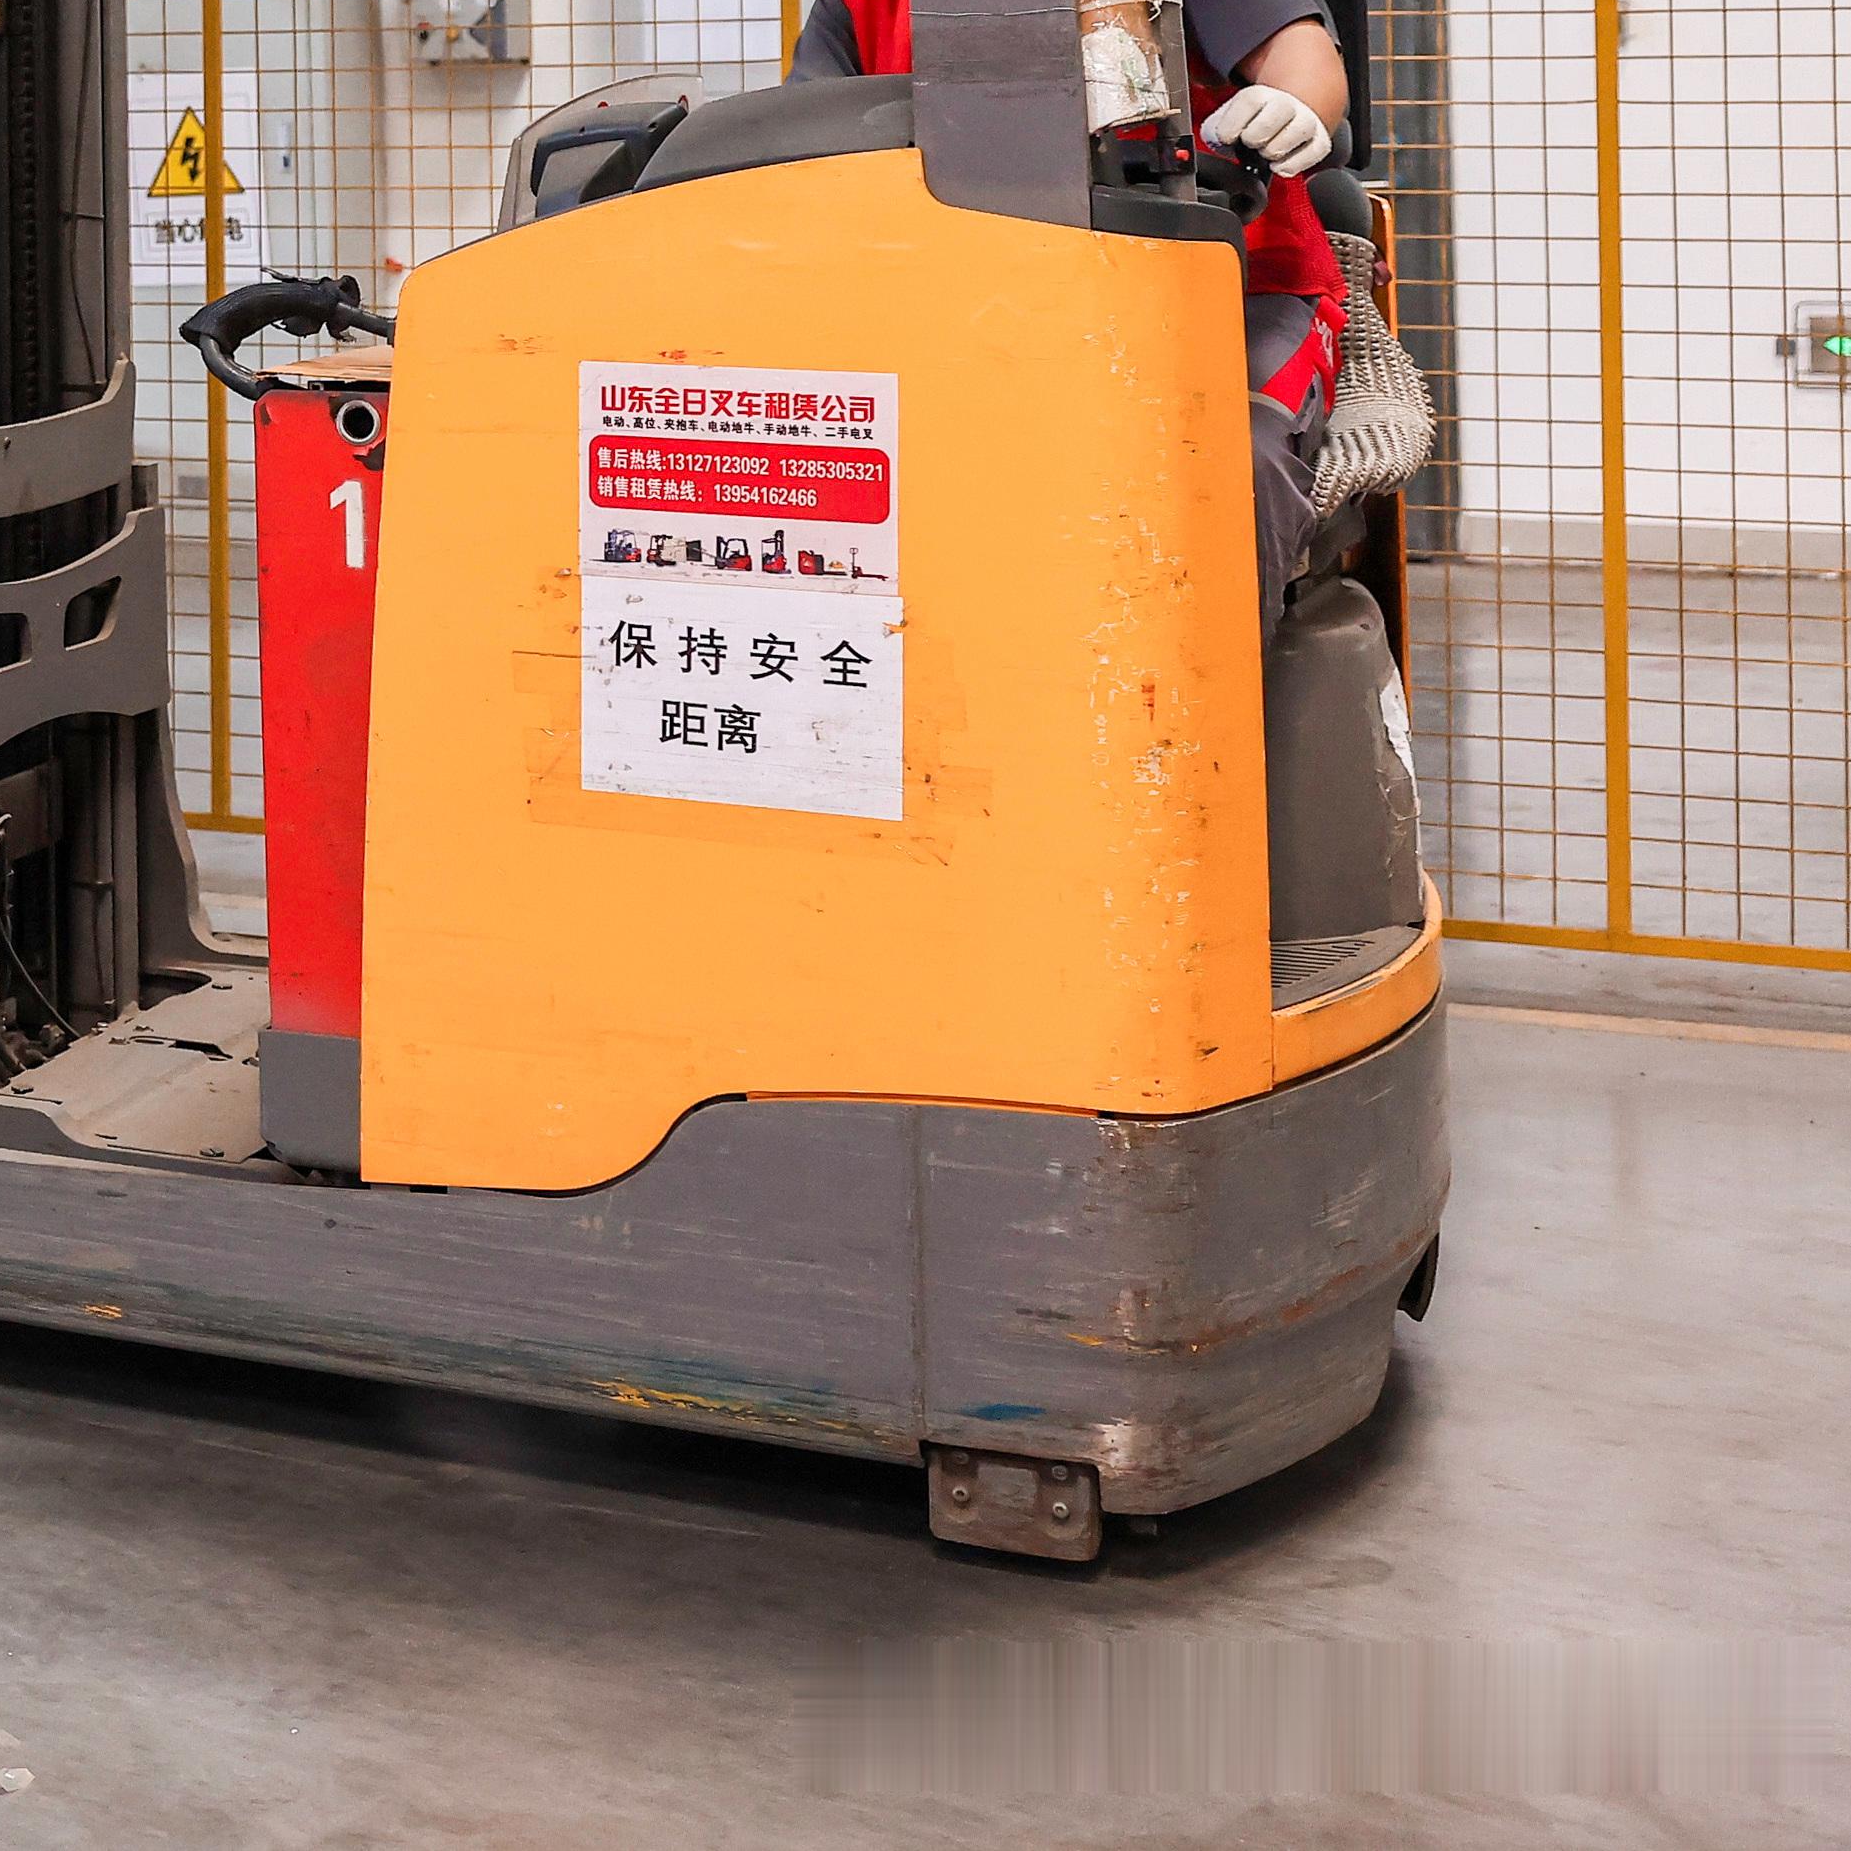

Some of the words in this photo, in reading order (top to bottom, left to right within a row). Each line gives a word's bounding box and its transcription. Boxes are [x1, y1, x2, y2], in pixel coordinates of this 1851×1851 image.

[155, 217, 244, 244] 当心电
[600, 385, 876, 424] 山东全日叉车租赁公司
[778, 458, 884, 482] 13285305321
[713, 483, 818, 507] 13954162466
[329, 479, 365, 570] 1
[608, 619, 874, 690] 保持安全
[659, 698, 762, 755] 距离
